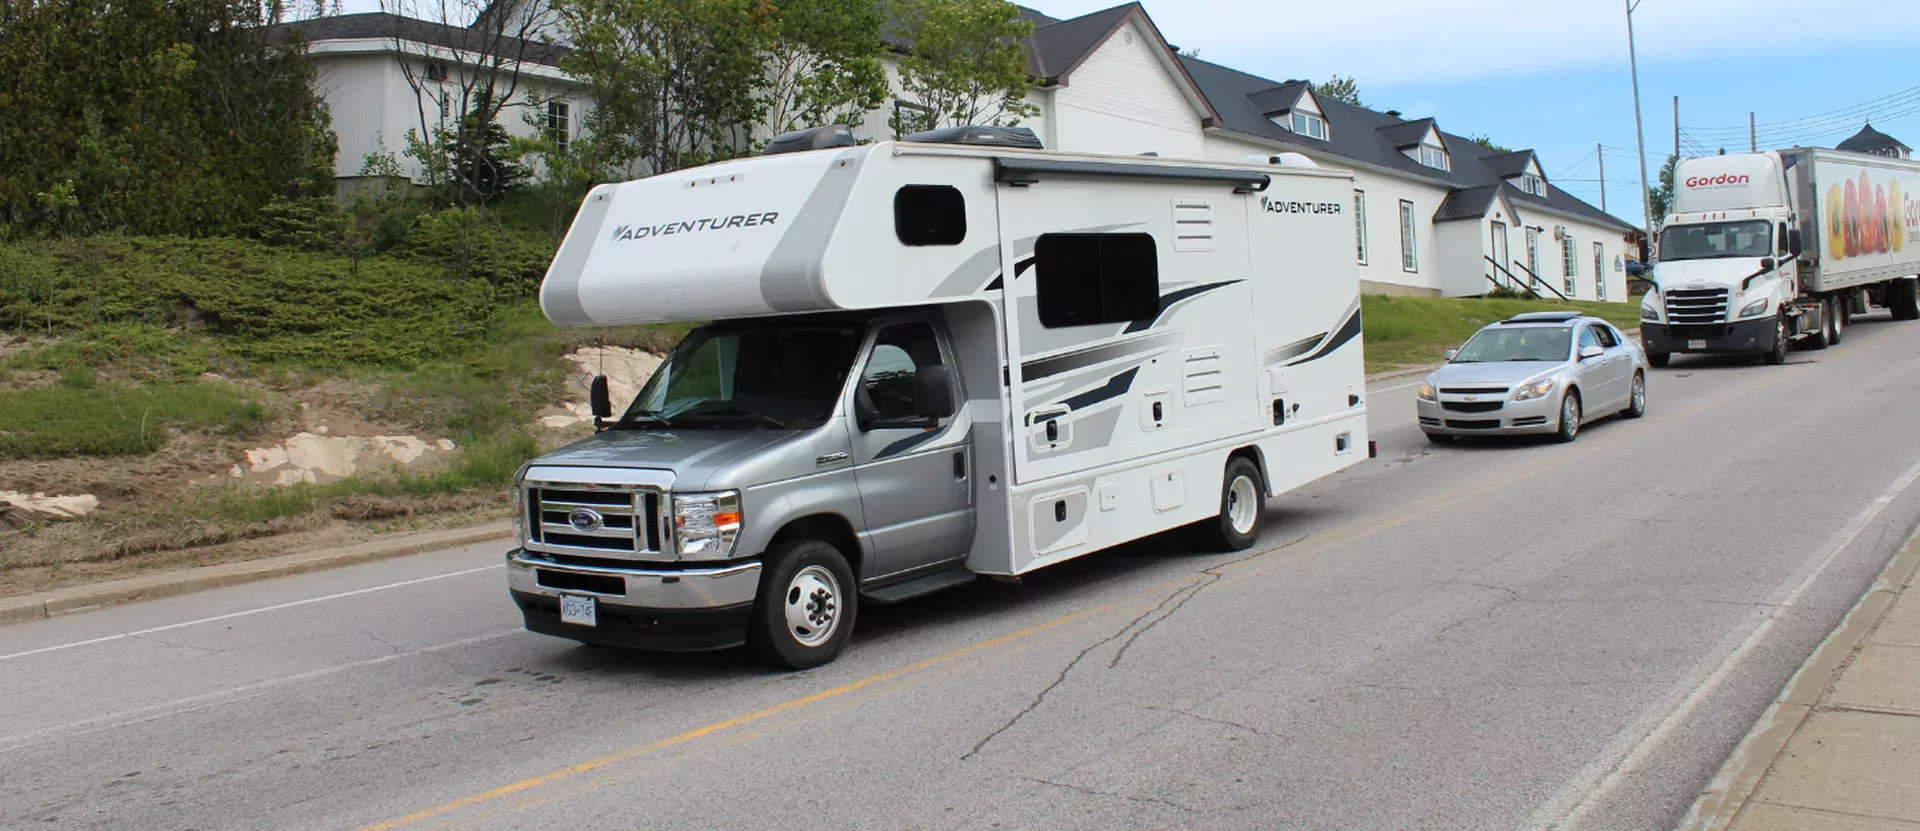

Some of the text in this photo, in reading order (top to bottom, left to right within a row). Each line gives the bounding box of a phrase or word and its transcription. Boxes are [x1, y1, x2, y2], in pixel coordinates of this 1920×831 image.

[1685, 174, 1749, 188] Gordon
[1267, 201, 1341, 214] ADVENTURER
[618, 212, 779, 242] ADVENTURER
